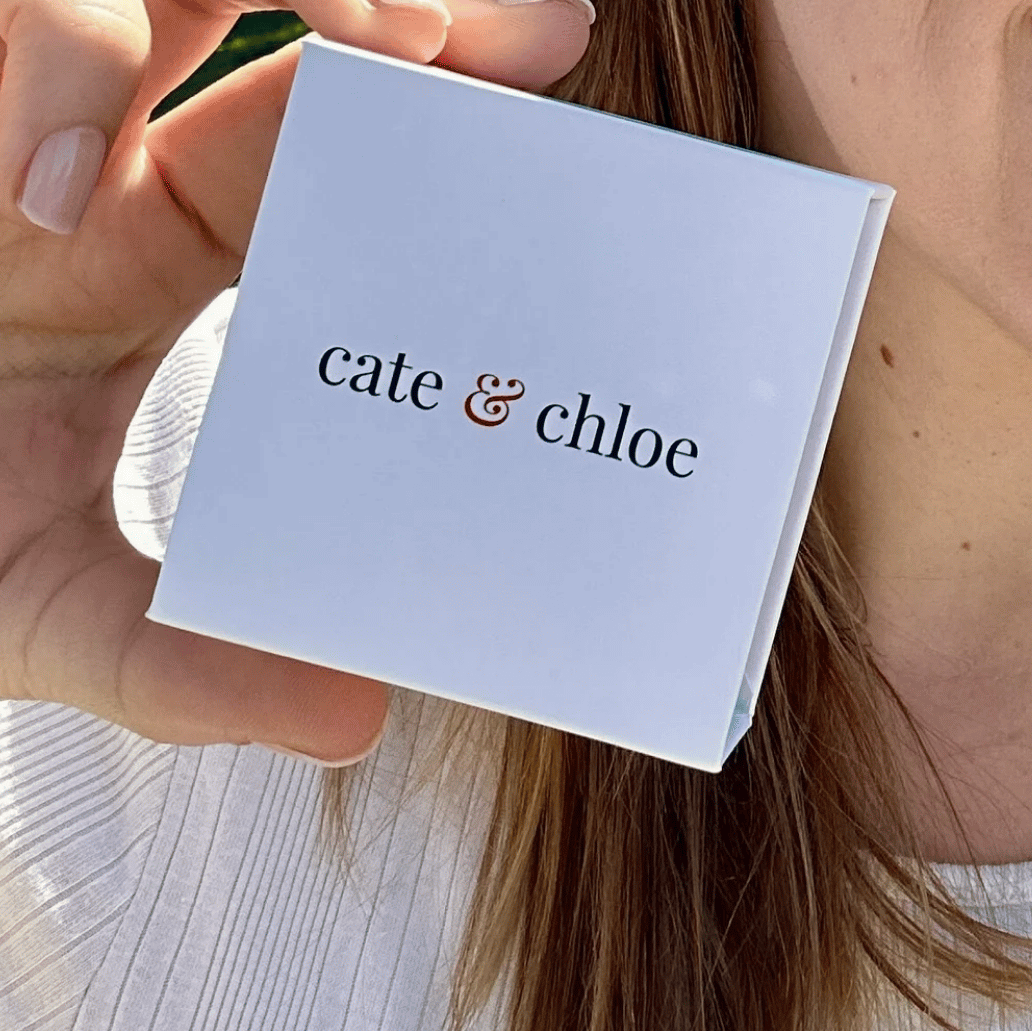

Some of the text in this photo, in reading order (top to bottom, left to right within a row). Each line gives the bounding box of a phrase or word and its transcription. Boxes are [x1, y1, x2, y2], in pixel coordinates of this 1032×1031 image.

[318, 346, 699, 478] cate & chloe
